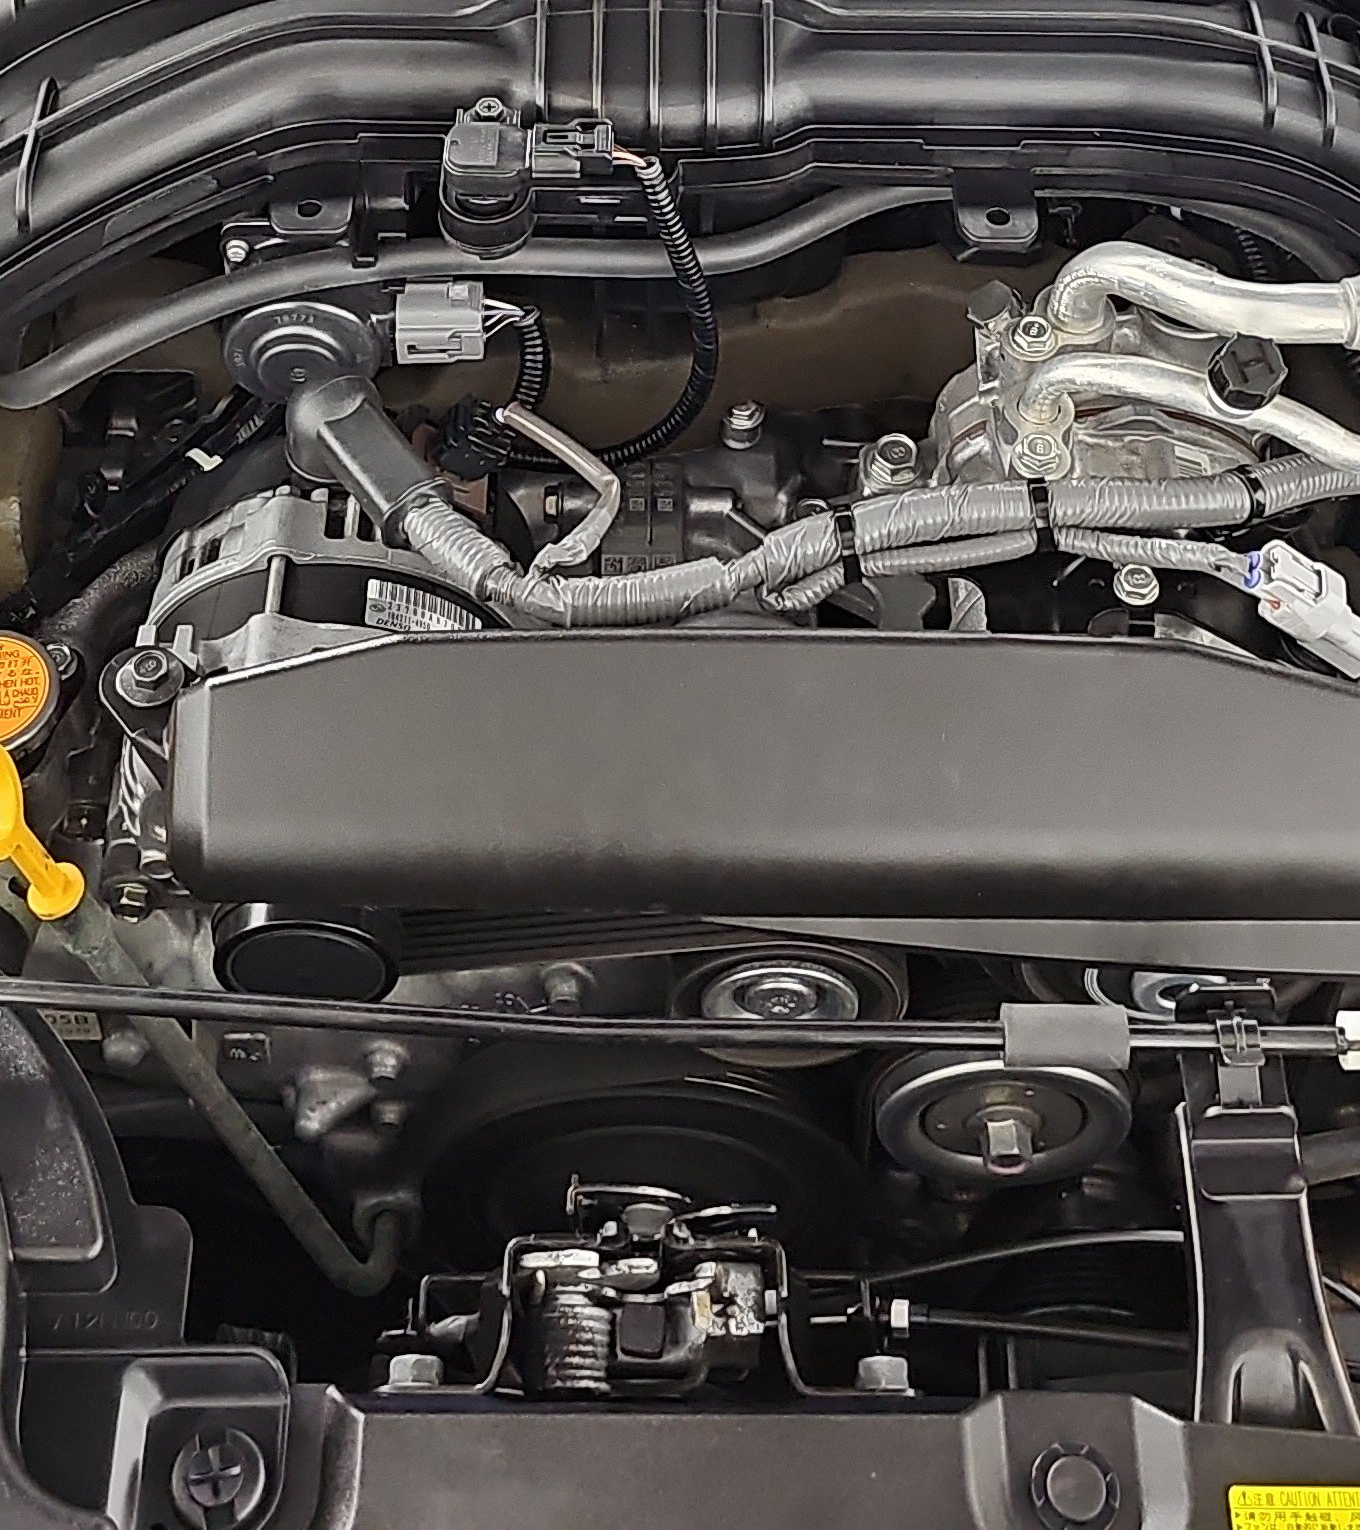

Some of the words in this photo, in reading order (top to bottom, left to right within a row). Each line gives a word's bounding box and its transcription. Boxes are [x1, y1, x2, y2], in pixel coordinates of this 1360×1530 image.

[375, 618, 411, 631] DENSO
[12, 687, 39, 698] CHAUD
[1279, 1491, 1321, 1507] CAUTION
